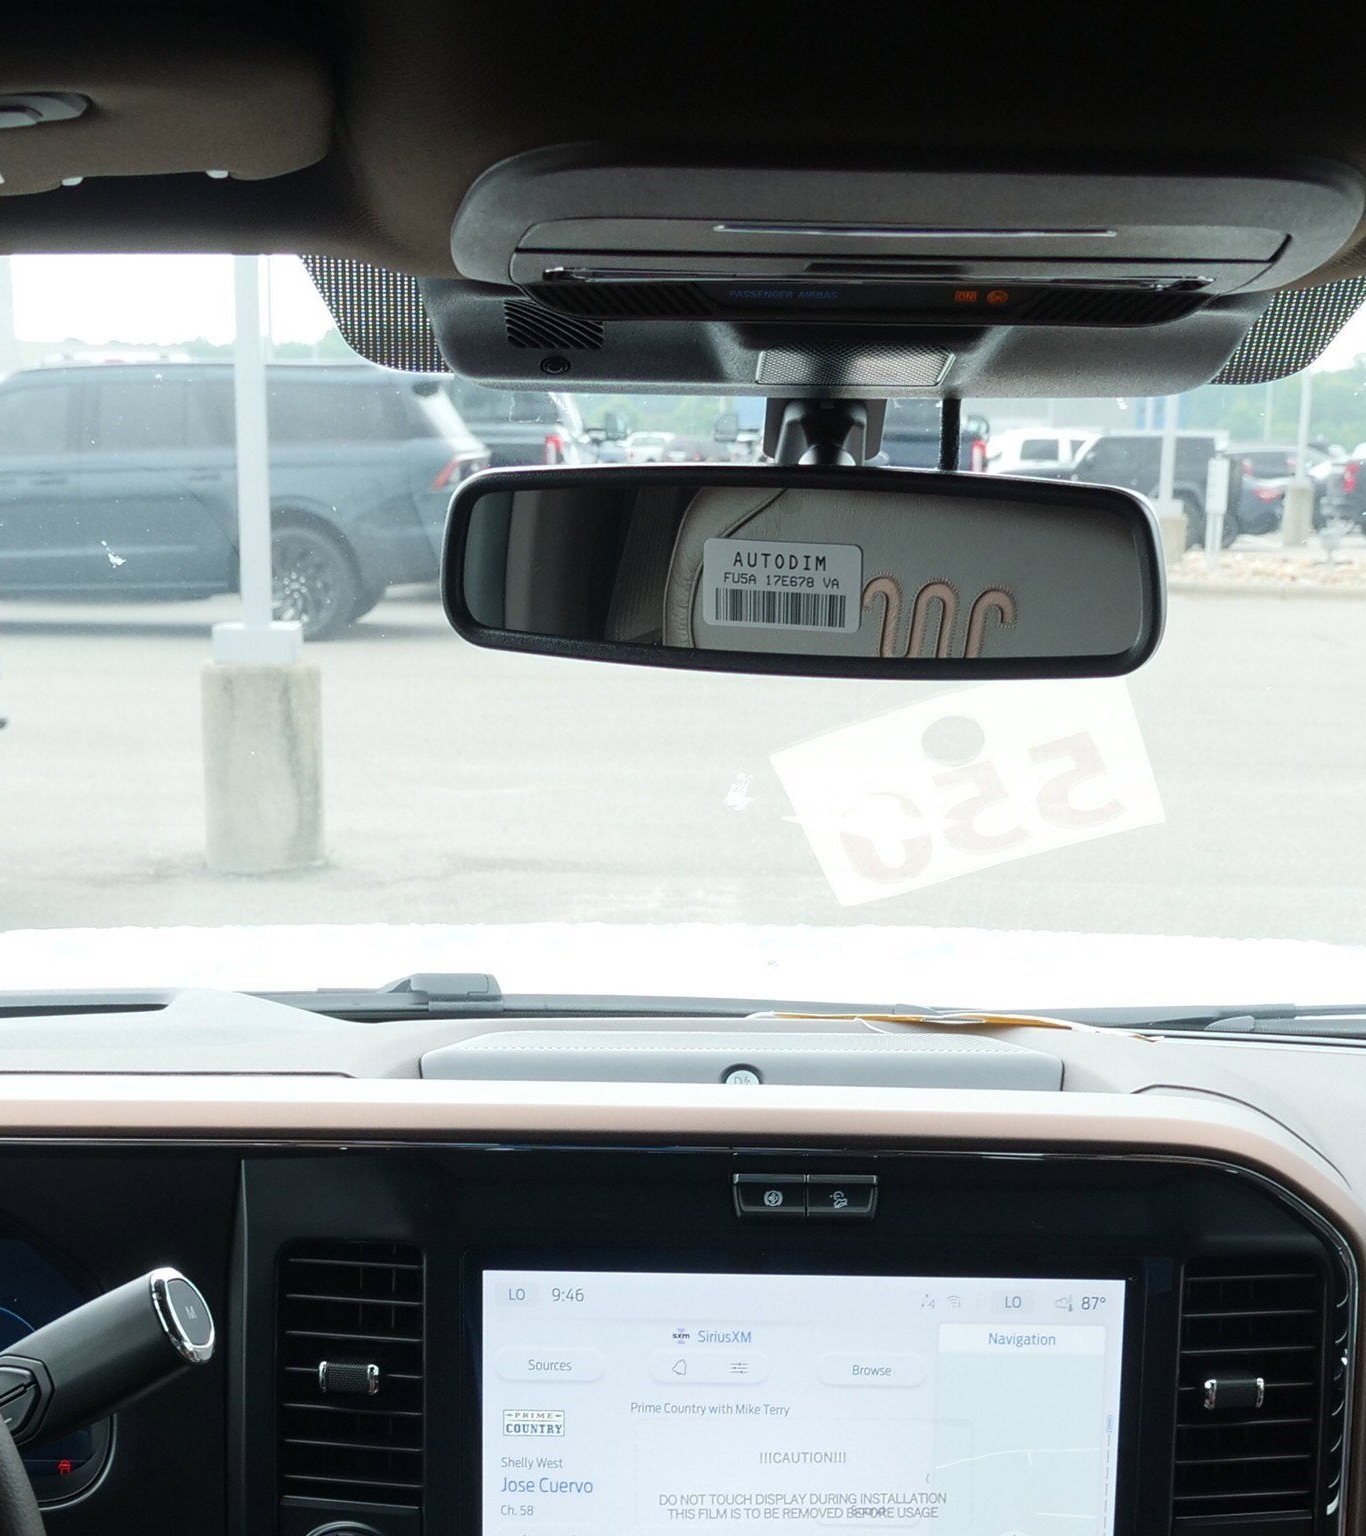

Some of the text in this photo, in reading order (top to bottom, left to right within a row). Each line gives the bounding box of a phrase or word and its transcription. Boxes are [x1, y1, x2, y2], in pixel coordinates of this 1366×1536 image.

[733, 551, 827, 572] AUTODIM
[766, 574, 815, 589] 17E678
[823, 577, 840, 590] VA
[508, 1288, 526, 1301] LO
[551, 1287, 585, 1303] 9:46
[1004, 1296, 1022, 1309] LO
[1081, 1297, 1106, 1311] 87°
[185, 1305, 198, 1321] M
[697, 1330, 752, 1344] SiriusXM
[988, 1332, 1056, 1347] Navigation
[528, 1359, 572, 1372] Sources
[852, 1365, 892, 1377] Browse
[514, 1412, 554, 1420] PRIME
[630, 1402, 790, 1417] Prime Country with Mike Terry
[505, 1423, 563, 1434] COUNTRY
[501, 1456, 563, 1470] Shelly West
[501, 1477, 593, 1494] Jose Cuervo
[659, 1493, 947, 1506] DO NOT TOUCH DISPLAY DURING INSTALLATION
[501, 1504, 534, 1516] Ch. 58
[668, 1508, 695, 1519] THIS
[698, 1508, 728, 1519] FILM
[730, 1508, 741, 1519] IS
[744, 1508, 760, 1519] TO
[764, 1508, 780, 1519] BE
[783, 1507, 843, 1519] REMOVED
[846, 1507, 895, 1519] BEFORE
[897, 1507, 939, 1519] USAGE
